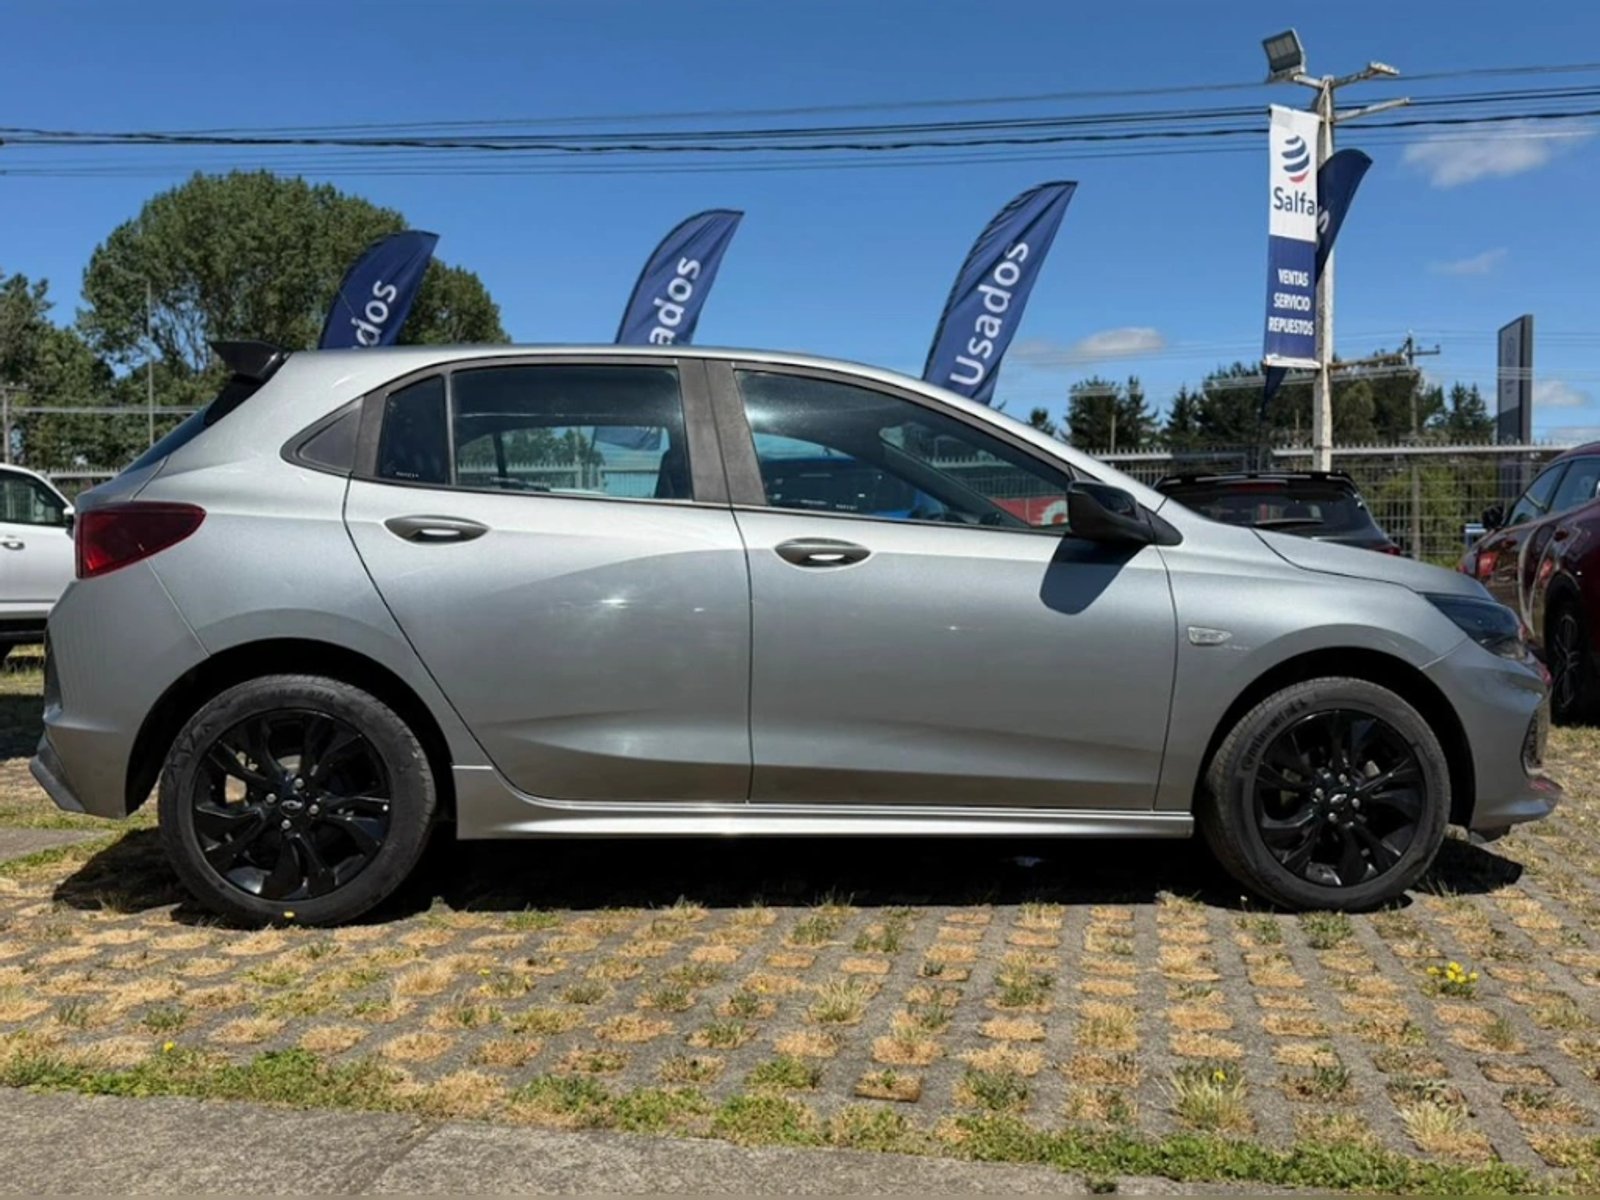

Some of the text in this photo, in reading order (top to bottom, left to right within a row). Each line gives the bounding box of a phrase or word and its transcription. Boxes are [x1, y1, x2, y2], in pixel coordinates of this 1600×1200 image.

[1273, 186, 1315, 216] Salfa
[1278, 268, 1309, 288] VENTAS
[351, 280, 397, 348] dos
[949, 241, 1029, 386] Usados
[1273, 292, 1311, 312] SERVICIO
[1268, 316, 1314, 336] REPUESTOS
